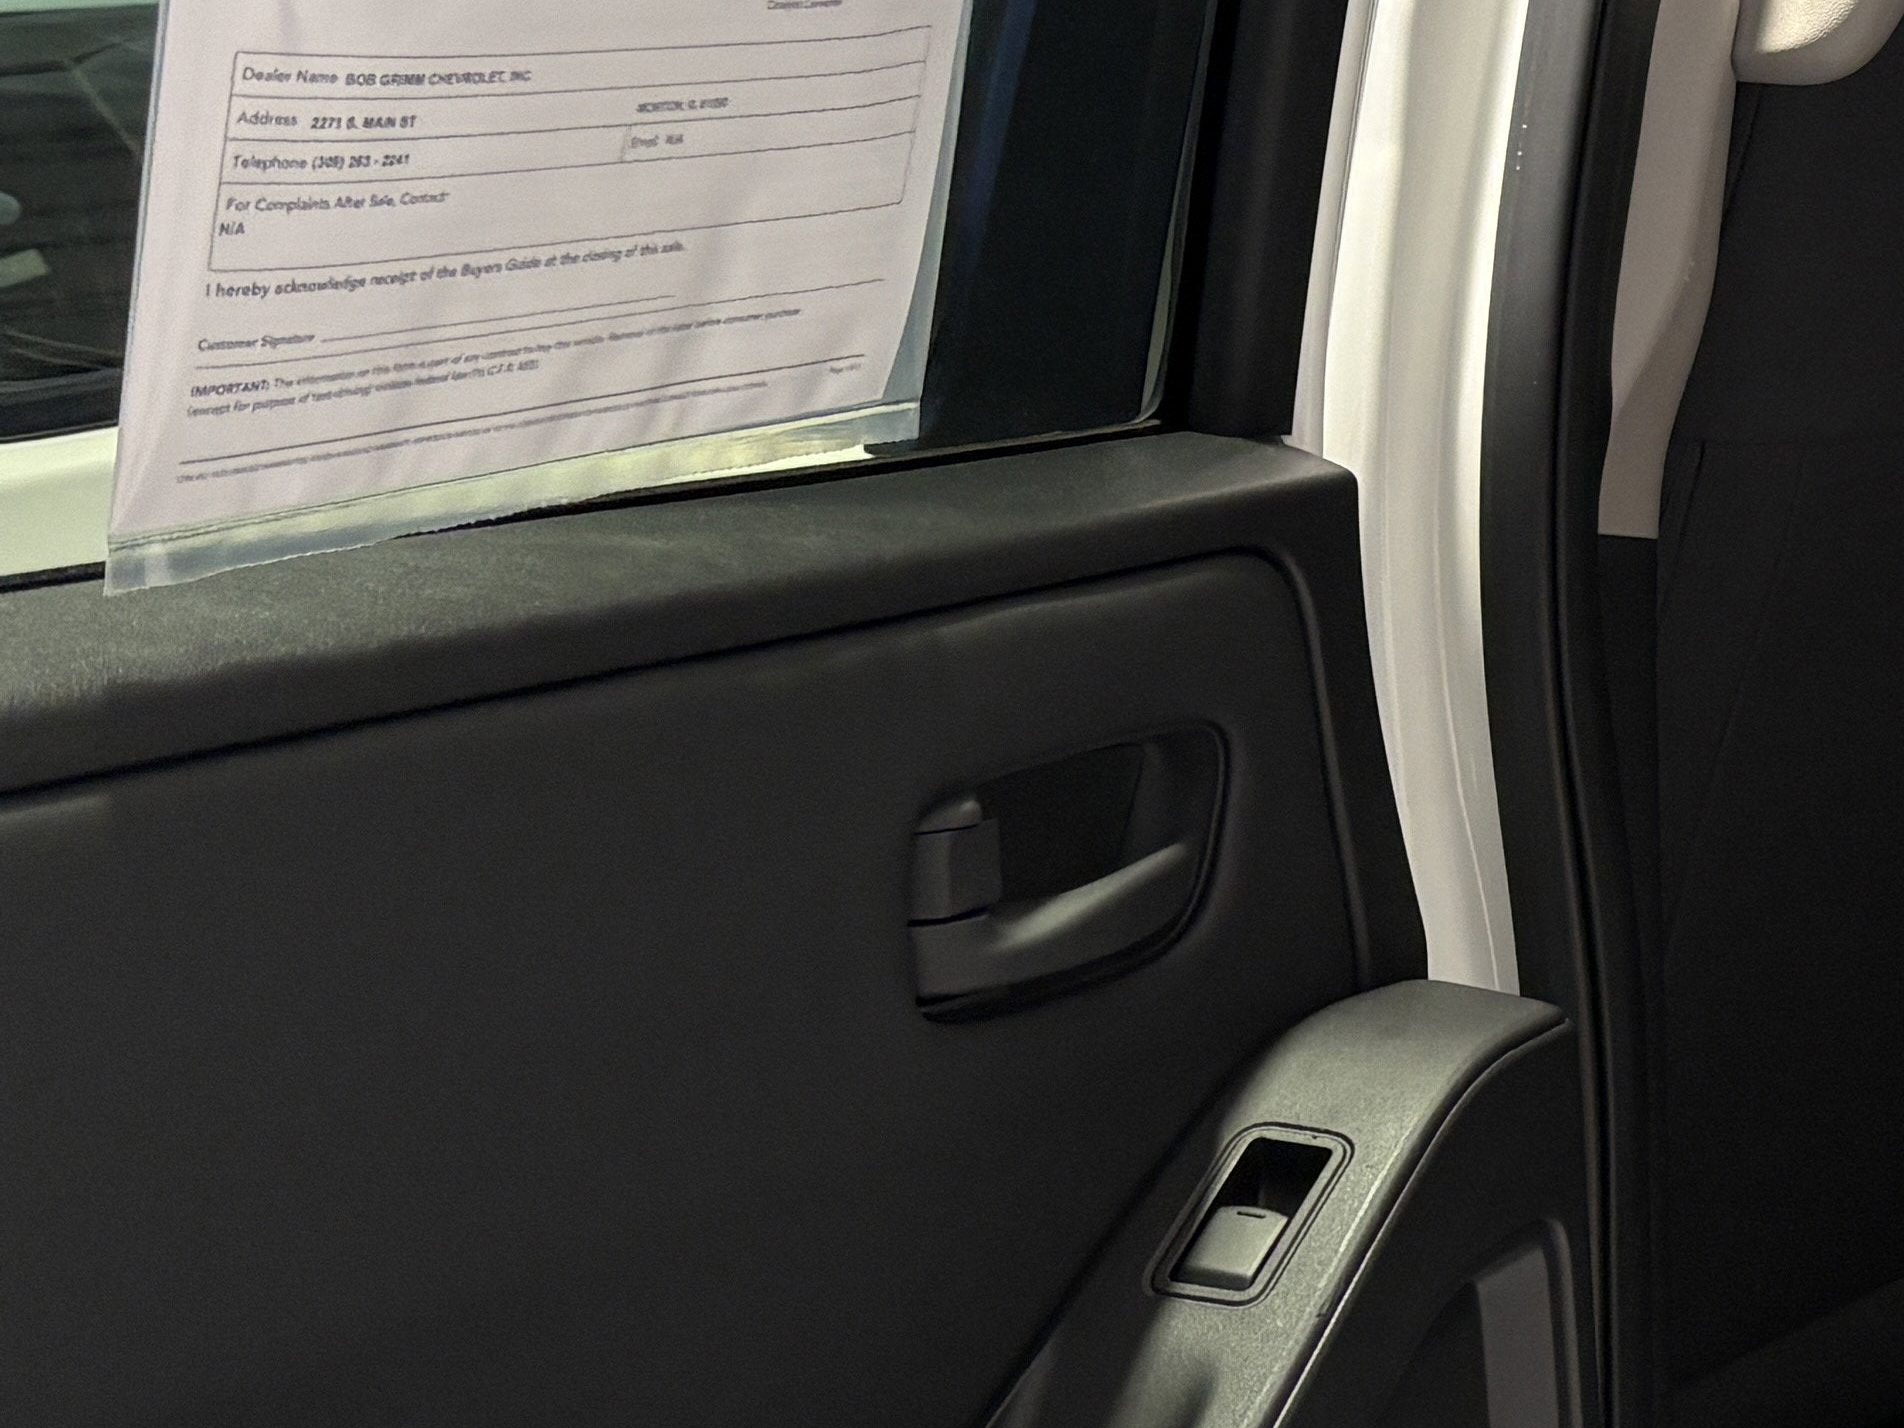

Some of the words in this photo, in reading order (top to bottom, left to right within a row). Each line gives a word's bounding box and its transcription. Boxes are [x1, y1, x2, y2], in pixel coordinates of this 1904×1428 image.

[242, 66, 292, 83] Dealer
[296, 69, 338, 84] Name
[345, 73, 376, 85] BOB
[236, 111, 299, 127] Address
[232, 154, 307, 171] Telephone
[226, 198, 250, 212] For
[255, 197, 330, 215] Complaints
[334, 195, 365, 209] After
[218, 221, 245, 236] N/A
[205, 283, 211, 297] I
[215, 282, 270, 299] hereby
[274, 275, 366, 296] acknowledge
[370, 270, 416, 290] receipt
[419, 266, 434, 282] of
[436, 264, 457, 280] the
[505, 256, 544, 272] Guide
[547, 256, 558, 269] at
[190, 379, 271, 398] IMPORTANT:
